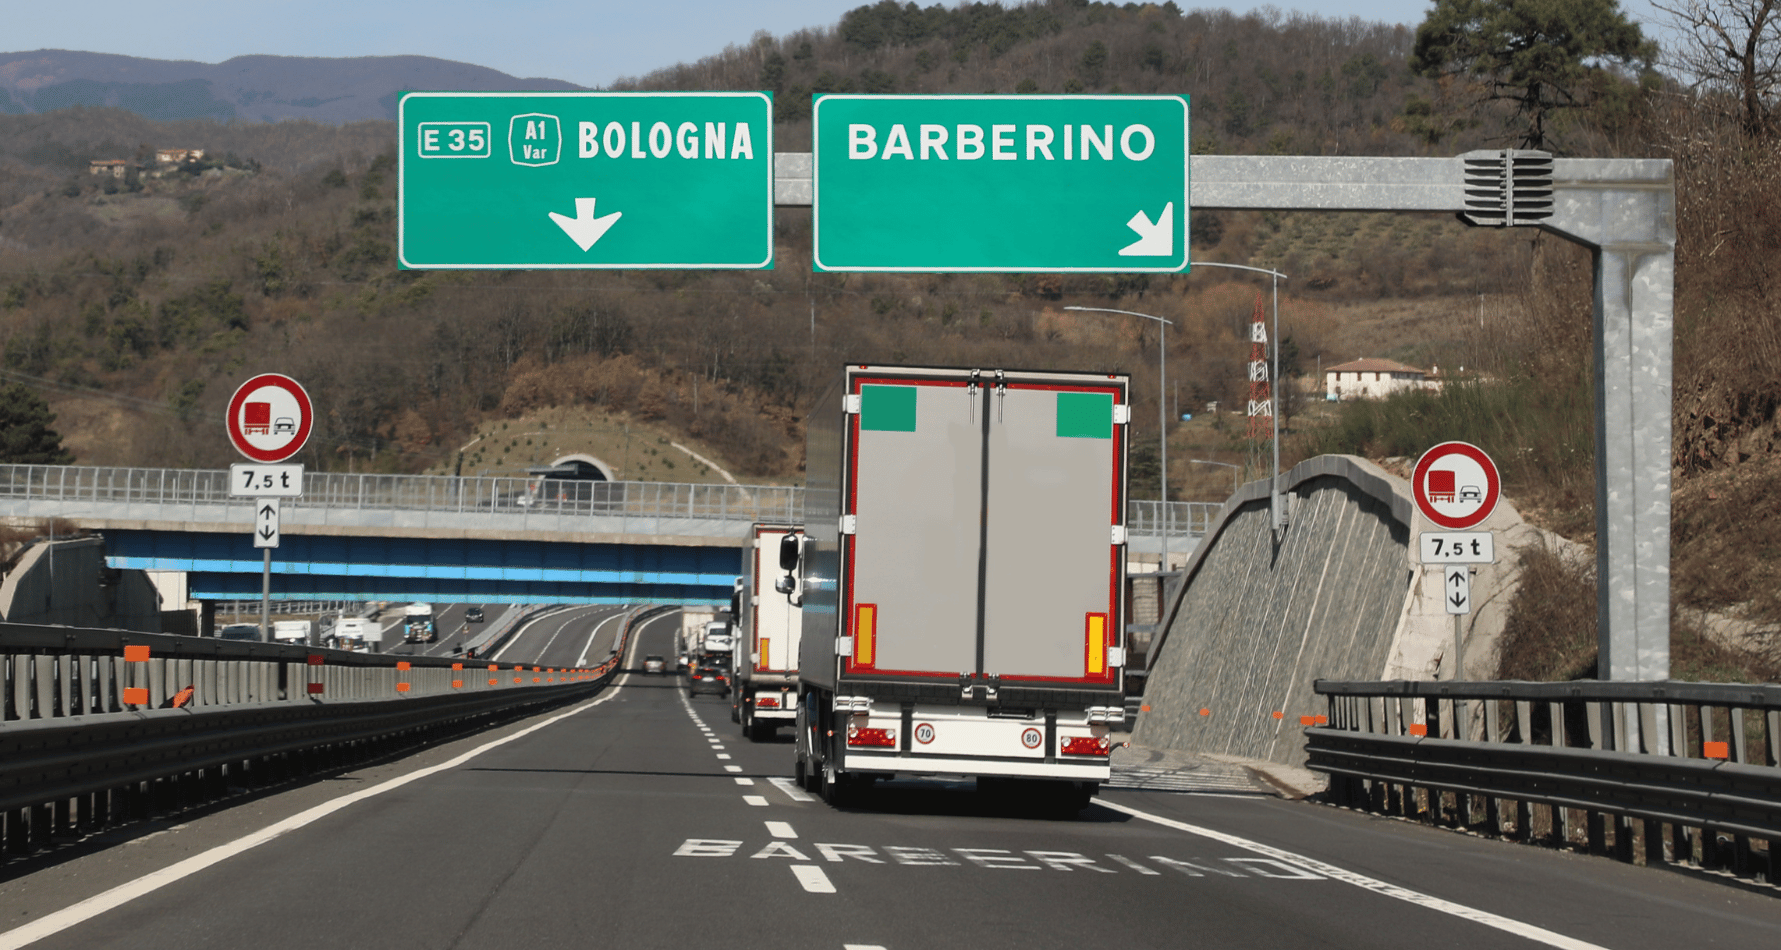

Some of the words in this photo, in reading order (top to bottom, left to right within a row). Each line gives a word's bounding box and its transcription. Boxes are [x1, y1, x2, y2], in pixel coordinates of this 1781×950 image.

[525, 120, 546, 140] A1
[424, 129, 440, 151] E
[448, 129, 485, 151] 35
[578, 121, 754, 159] BOLOGNA
[848, 123, 1156, 162] BARBERINO
[523, 145, 547, 159] Var
[242, 471, 274, 490] 7,5
[280, 471, 290, 489] t
[1431, 538, 1463, 557] 7,5
[1470, 538, 1481, 556] t
[920, 728, 931, 738] 70
[1026, 733, 1038, 743] 80
